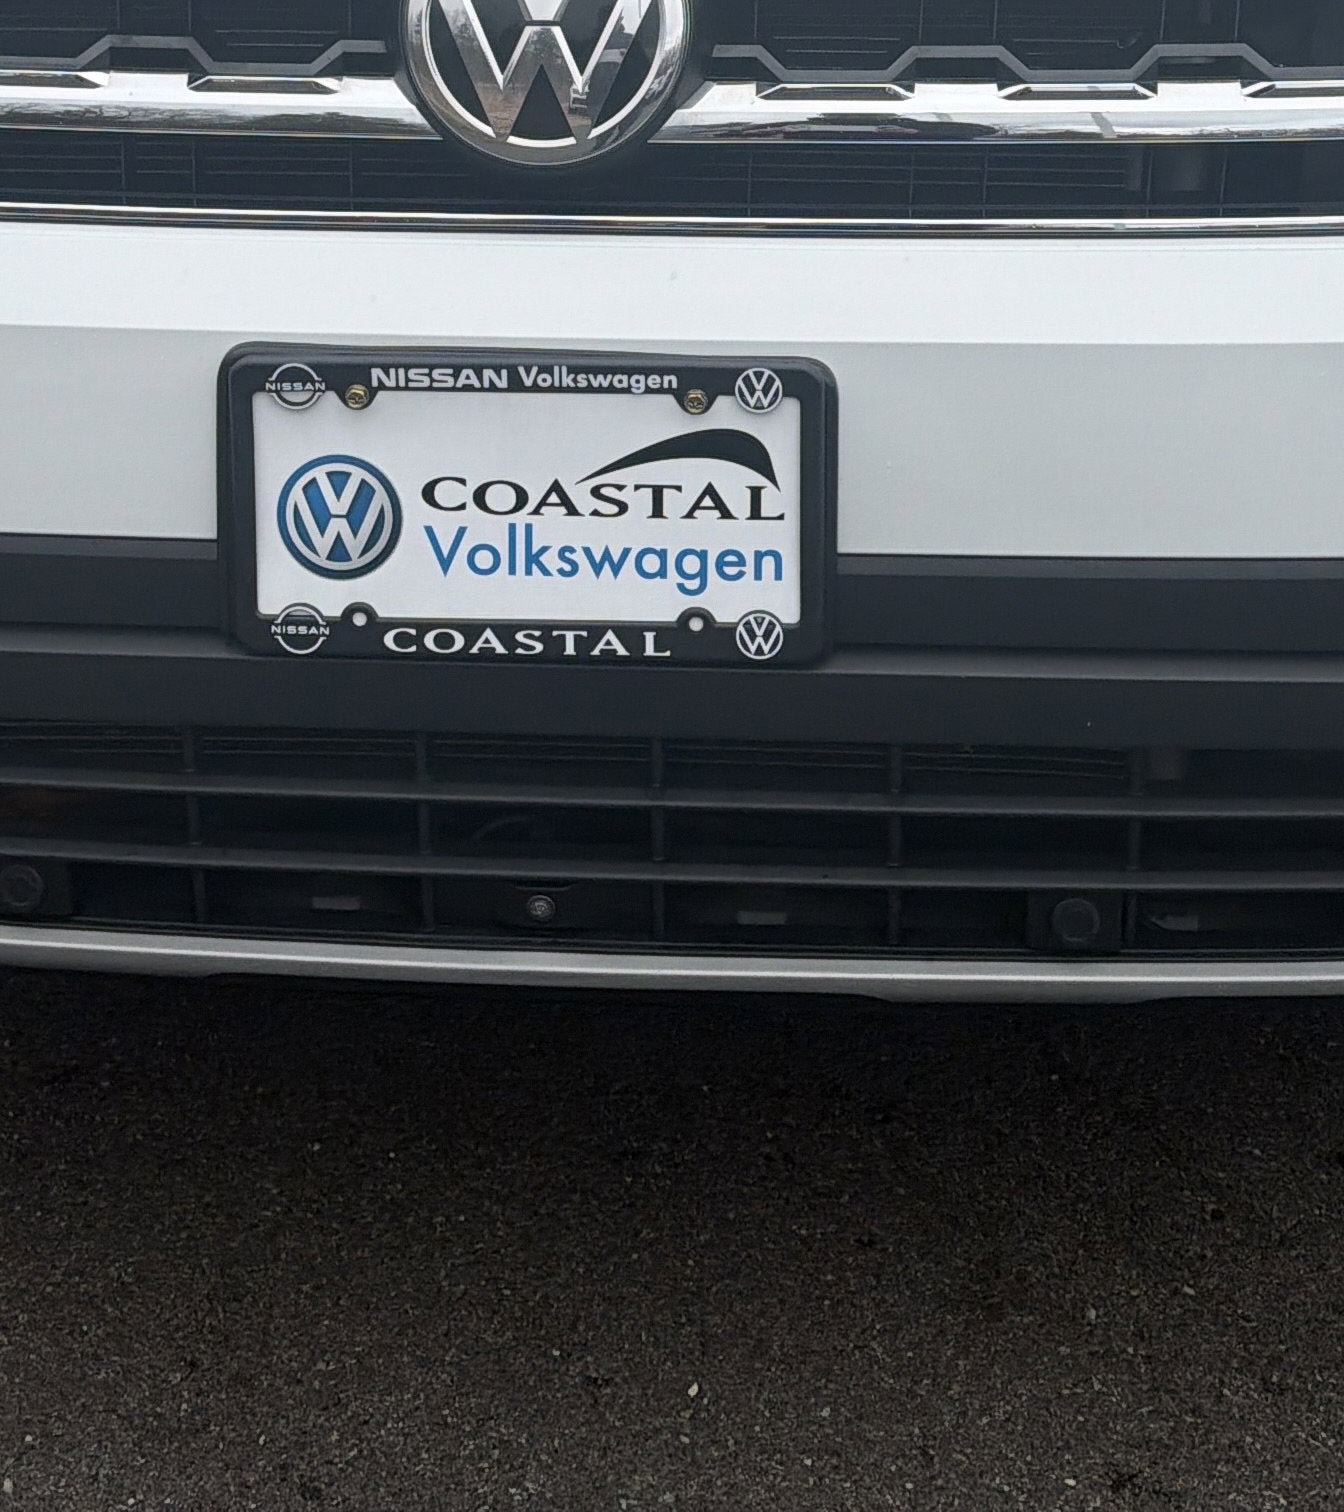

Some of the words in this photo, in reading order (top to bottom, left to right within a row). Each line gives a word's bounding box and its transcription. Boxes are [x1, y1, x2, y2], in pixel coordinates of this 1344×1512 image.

[265, 381, 326, 391] NISSAN
[370, 367, 508, 389] NISSAN
[517, 365, 678, 394] Volkswagen
[421, 476, 786, 522] COASTAL
[423, 523, 784, 597] Volkswagen
[271, 624, 330, 636] NISSAN
[383, 627, 671, 657] COASTAL
